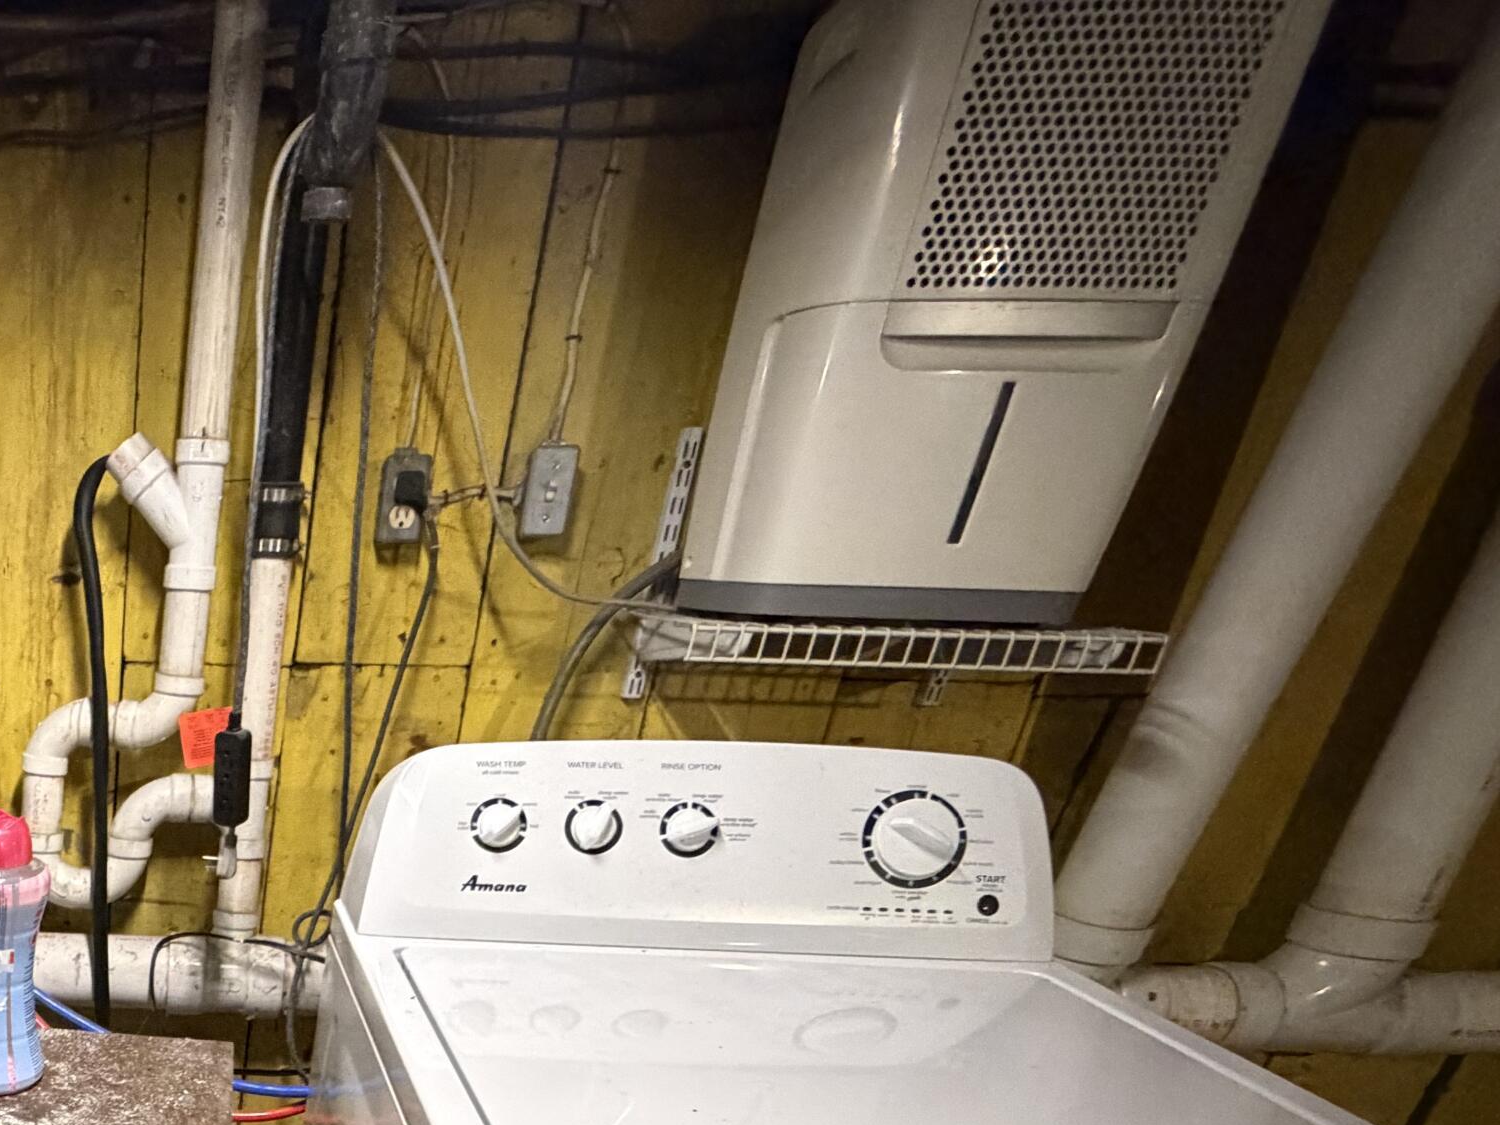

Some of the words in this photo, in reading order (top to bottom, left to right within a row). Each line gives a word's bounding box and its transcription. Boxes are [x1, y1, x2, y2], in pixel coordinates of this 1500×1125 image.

[476, 760, 501, 768] WASH
[504, 760, 526, 768] TEMP
[567, 761, 597, 769] WATER
[598, 761, 624, 770] LEVEL
[660, 762, 685, 771] RINSE
[687, 763, 722, 771] OPTION
[460, 874, 527, 892] Amana
[975, 875, 1006, 883] START
